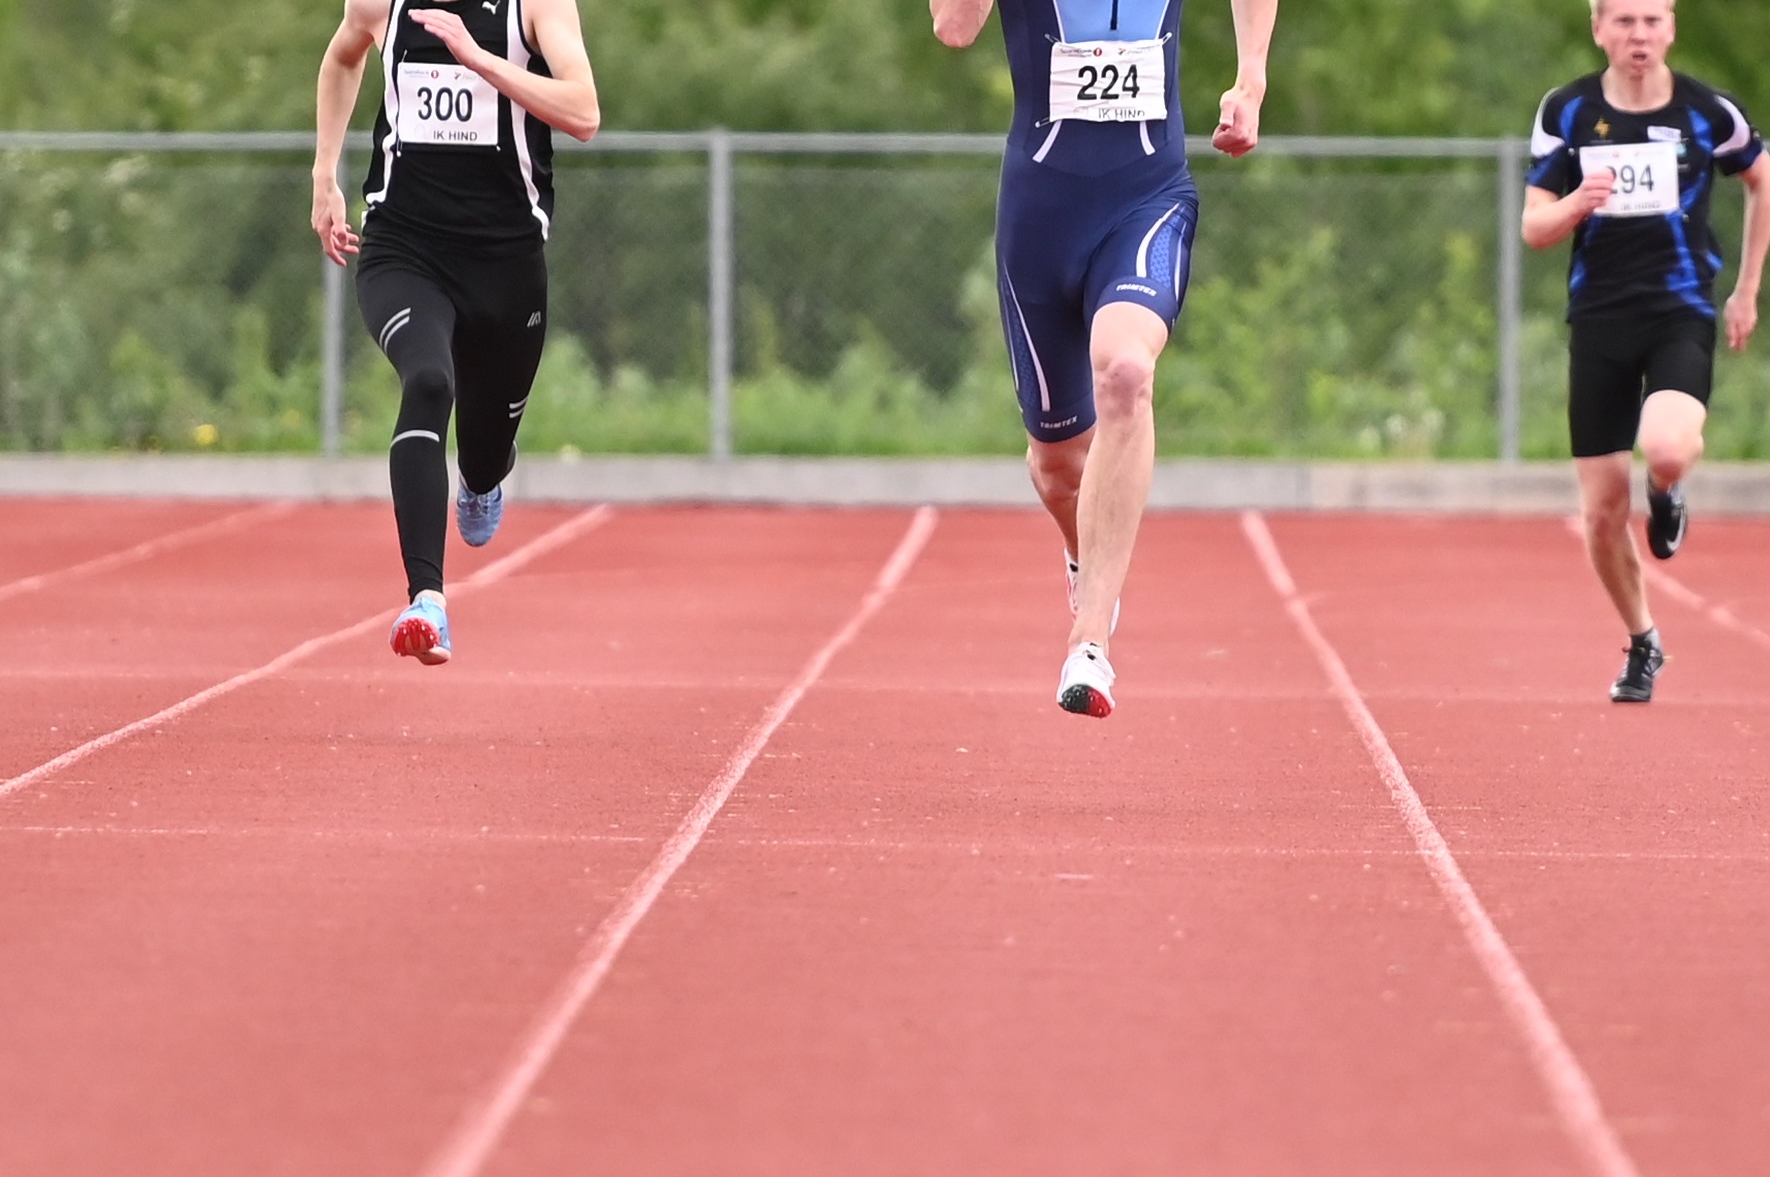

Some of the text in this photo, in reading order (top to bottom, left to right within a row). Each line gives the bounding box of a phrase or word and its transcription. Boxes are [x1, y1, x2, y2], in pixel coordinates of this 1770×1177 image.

[1077, 64, 1140, 100] 224
[417, 86, 473, 123] 300
[433, 130, 478, 142] IK HIND
